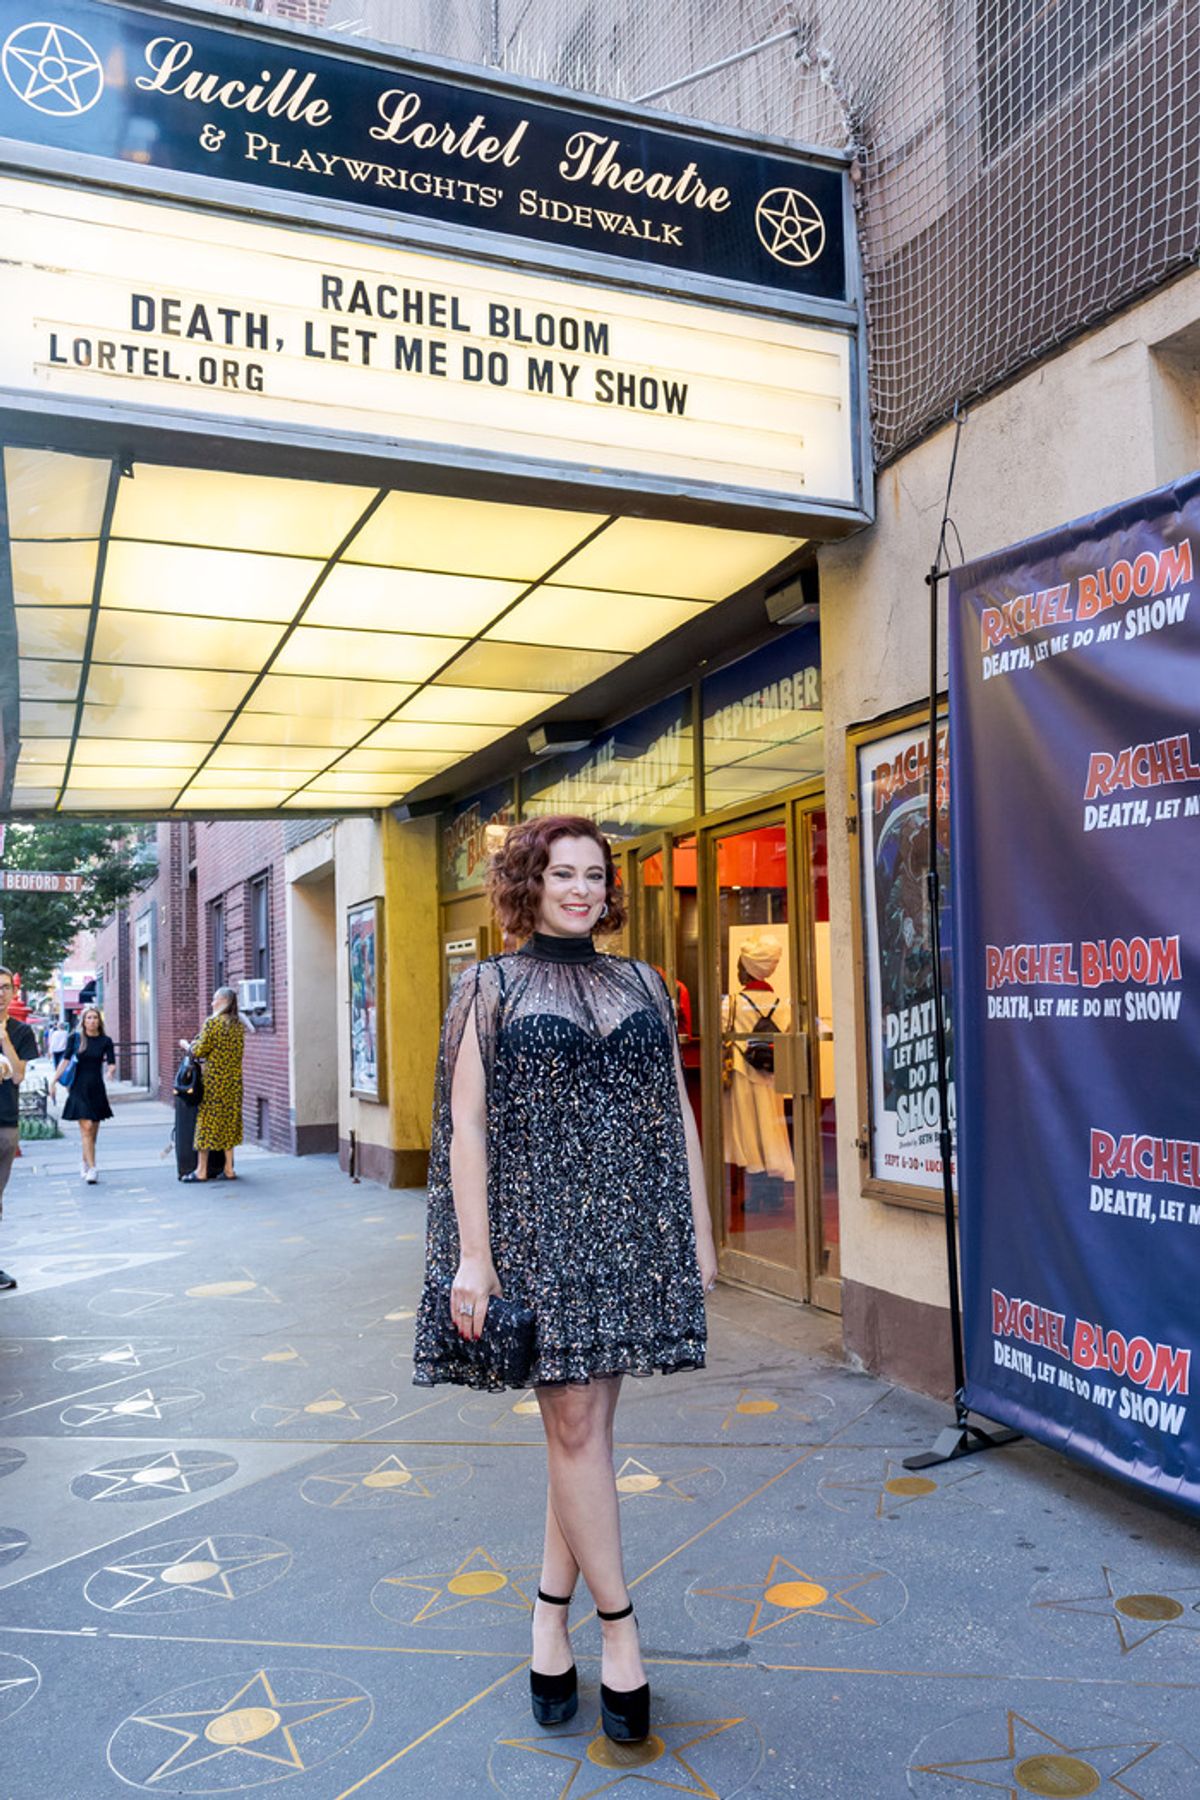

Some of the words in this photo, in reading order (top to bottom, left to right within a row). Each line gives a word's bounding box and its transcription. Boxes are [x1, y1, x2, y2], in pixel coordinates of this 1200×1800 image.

[135, 37, 332, 127] Lucille
[369, 88, 530, 168] Lortel
[559, 131, 732, 213] Theatre
[199, 123, 226, 152] &
[519, 189, 683, 247] SIDEWALK
[322, 274, 470, 332] RACHEL
[489, 303, 610, 356] BLOOM
[50, 333, 264, 393] LORTEL.ORG
[131, 293, 284, 353] DEATH,
[304, 321, 377, 367] LET
[395, 334, 447, 377] ME
[462, 346, 509, 387] DO
[528, 358, 581, 398] MY
[595, 369, 689, 416] SHOW
[981, 583, 1073, 652] RACHEL
[1076, 538, 1193, 621] BLOOM
[983, 645, 1034, 681] DEATH,
[1034, 639, 1049, 662] LET
[1051, 634, 1069, 656] ME
[1073, 629, 1094, 648] DO
[1096, 620, 1122, 643] MY
[1124, 592, 1190, 641] SHOW
[713, 665, 819, 744] SEPTEMBER
[1084, 733, 1200, 800] RACHEL
[1083, 800, 1151, 832] DEATH,
[1155, 798, 1181, 820] LET
[1184, 795, 1200, 817] M
[6, 873, 59, 891] BEDFORD
[64, 876, 79, 891] ST
[986, 943, 1079, 990] RACHEL
[1080, 935, 1182, 989] BLOOM
[987, 995, 1032, 1022] DEATH,
[1034, 998, 1054, 1016] LET
[1056, 999, 1078, 1017] ME
[1083, 999, 1101, 1017] DO
[1104, 998, 1121, 1017] MY
[1125, 991, 1182, 1022] SHOW
[893, 1045, 912, 1070] LET
[915, 1036, 934, 1063] ME
[909, 1065, 926, 1090] DO
[1089, 1128, 1200, 1189] RACHEL
[1090, 1184, 1156, 1224] DEATH,
[1159, 1199, 1185, 1222] LET
[1188, 1204, 1200, 1225] M
[992, 1288, 1070, 1360] RACHEL
[1072, 1318, 1191, 1396] BLOOM
[994, 1340, 1037, 1383] DEATH,
[1037, 1361, 1056, 1384] LET
[1058, 1368, 1075, 1392] ME
[1075, 1376, 1091, 1400] DO
[1092, 1384, 1117, 1409] MY
[1118, 1386, 1186, 1436] SHOW
